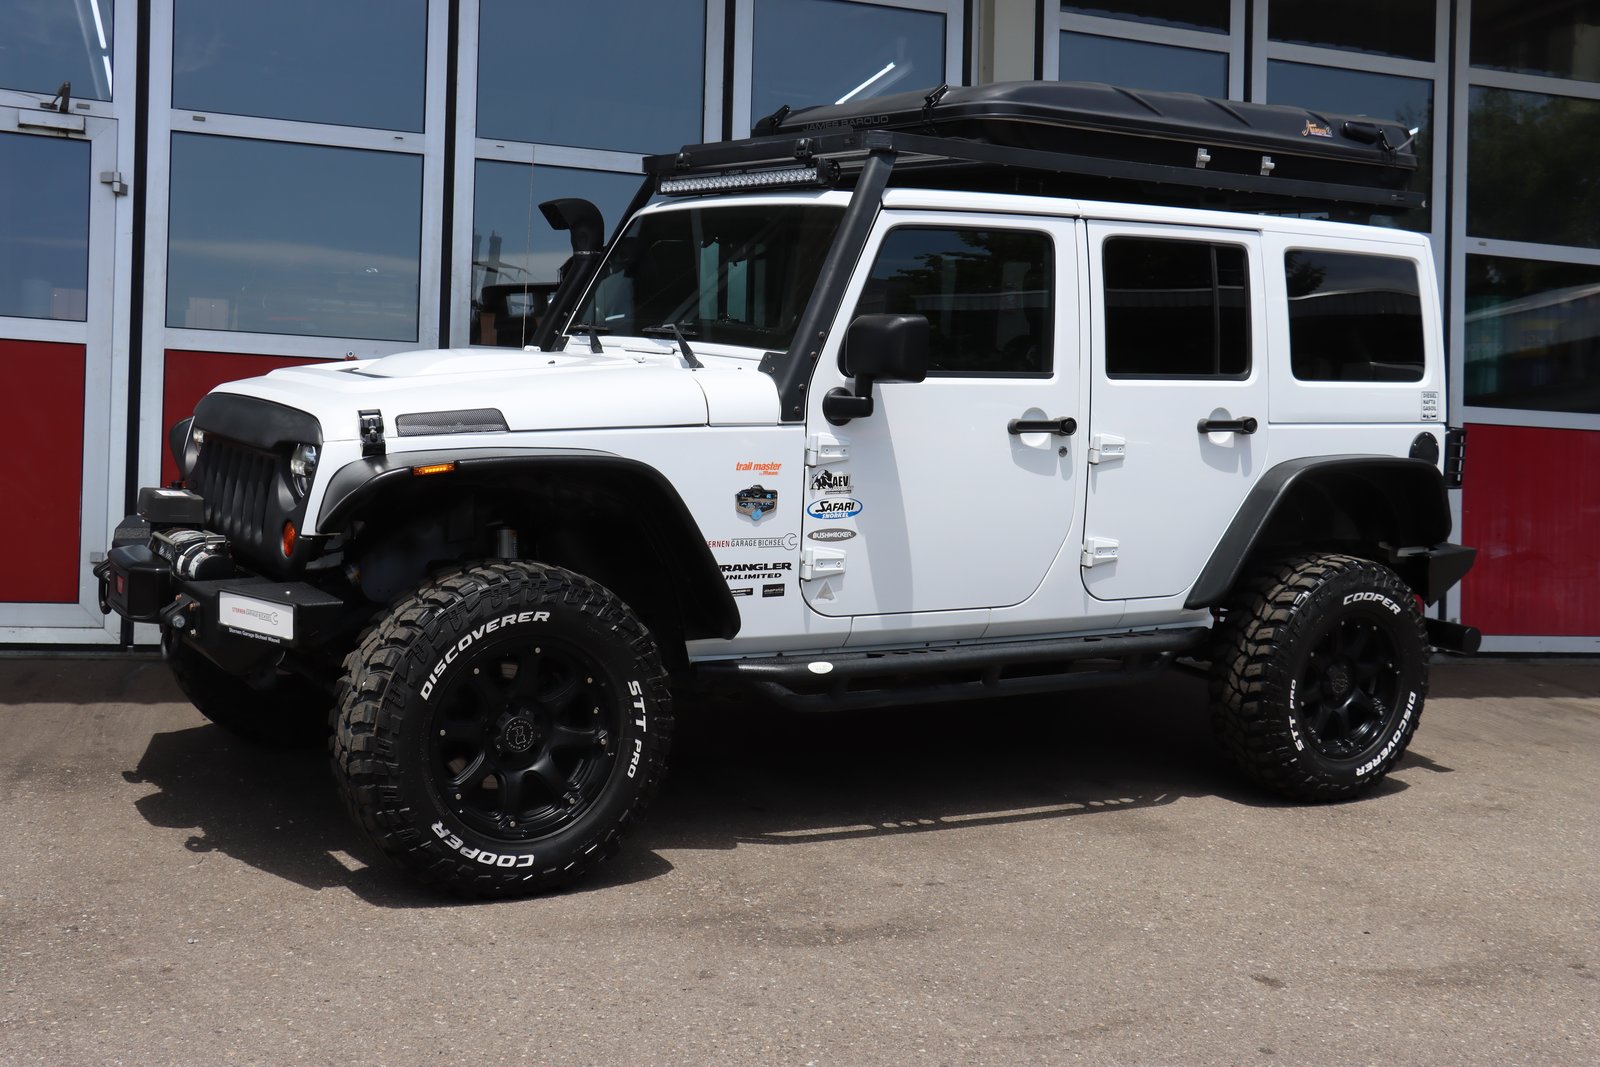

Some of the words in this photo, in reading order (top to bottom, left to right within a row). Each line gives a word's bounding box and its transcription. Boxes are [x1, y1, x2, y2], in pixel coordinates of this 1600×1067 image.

[841, 115, 889, 128] BAROUD
[736, 461, 753, 471] trail
[753, 461, 782, 471] master
[832, 475, 849, 487] AEV
[815, 500, 855, 513] SAFARI
[706, 540, 730, 548] ERNEN
[731, 539, 757, 547] GARAGE
[758, 538, 784, 547] BICHSEL
[1343, 592, 1401, 616] COOPER
[420, 611, 551, 701] DISCOVERER
[628, 680, 648, 732] STT
[1289, 716, 1305, 752] STT
[1356, 691, 1417, 777] DISCOVERER
[626, 739, 643, 779] PRO
[431, 820, 535, 868] COOPER
